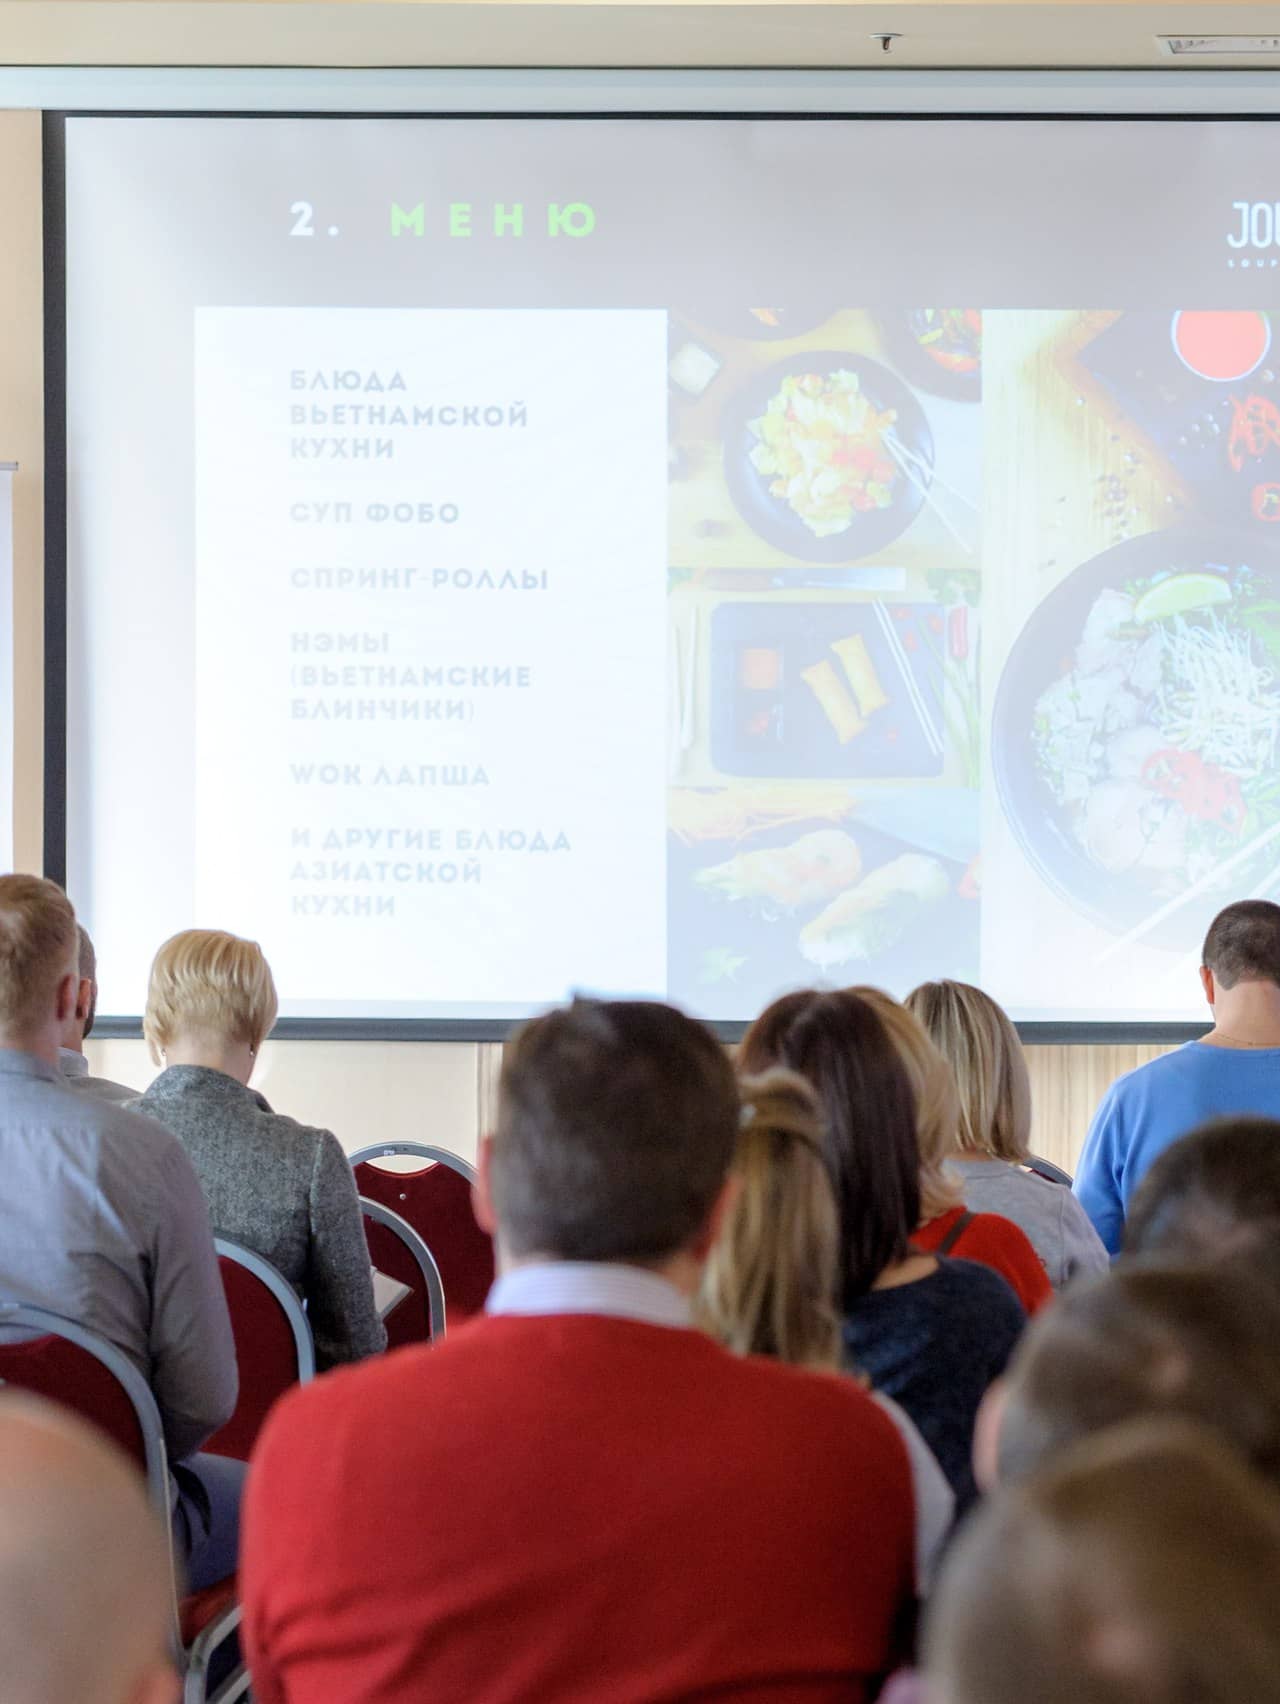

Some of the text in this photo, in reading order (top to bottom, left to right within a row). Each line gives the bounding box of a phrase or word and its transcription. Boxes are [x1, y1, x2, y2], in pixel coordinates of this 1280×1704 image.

[289, 201, 597, 237] 2. МЕНЮ
[290, 370, 408, 393] БЛЮДА
[290, 401, 528, 427] ВЬЕТНАМСКОЙ
[290, 438, 394, 459] КУХНИ
[290, 502, 460, 524] СУП ФОБО
[290, 567, 549, 590] СПРИНГ-РОЛЛЫ
[291, 632, 390, 653] НЭМЫ
[290, 665, 531, 688] (ВЬЕТНАМСКИЕ
[290, 699, 474, 721] БЛИНЧИКИ)
[373, 764, 490, 787] ЛАПША
[291, 828, 571, 852] И ДРУГИЕ БЛЮДА
[289, 858, 482, 884] АЗИАТСКОЙ
[291, 896, 396, 916] КУХНИ
